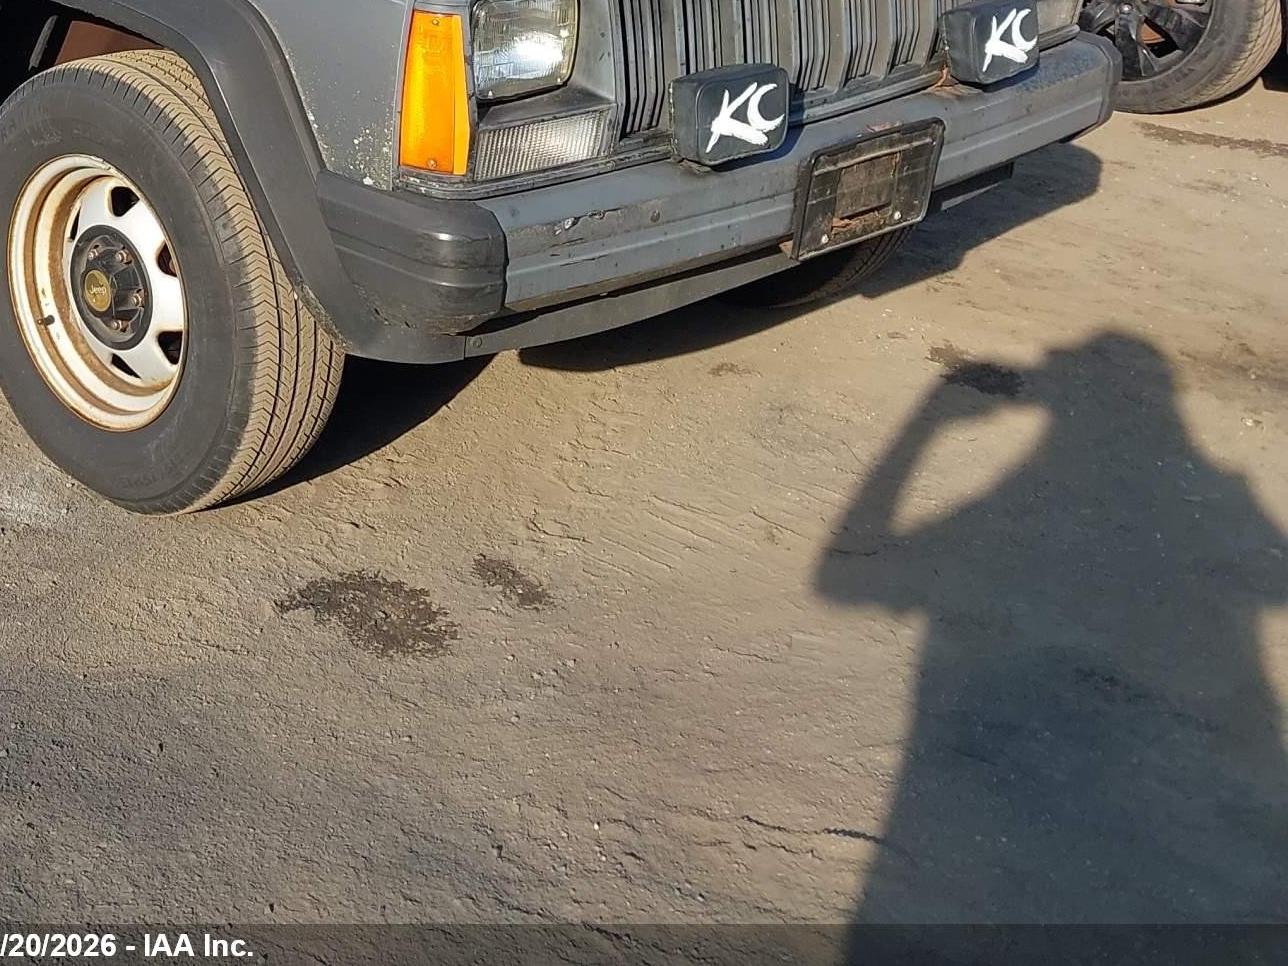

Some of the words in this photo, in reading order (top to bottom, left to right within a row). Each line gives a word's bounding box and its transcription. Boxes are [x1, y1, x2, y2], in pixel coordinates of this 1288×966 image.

[982, 8, 1038, 72] KC
[705, 82, 785, 154] KC
[89, 282, 107, 296] Jeep
